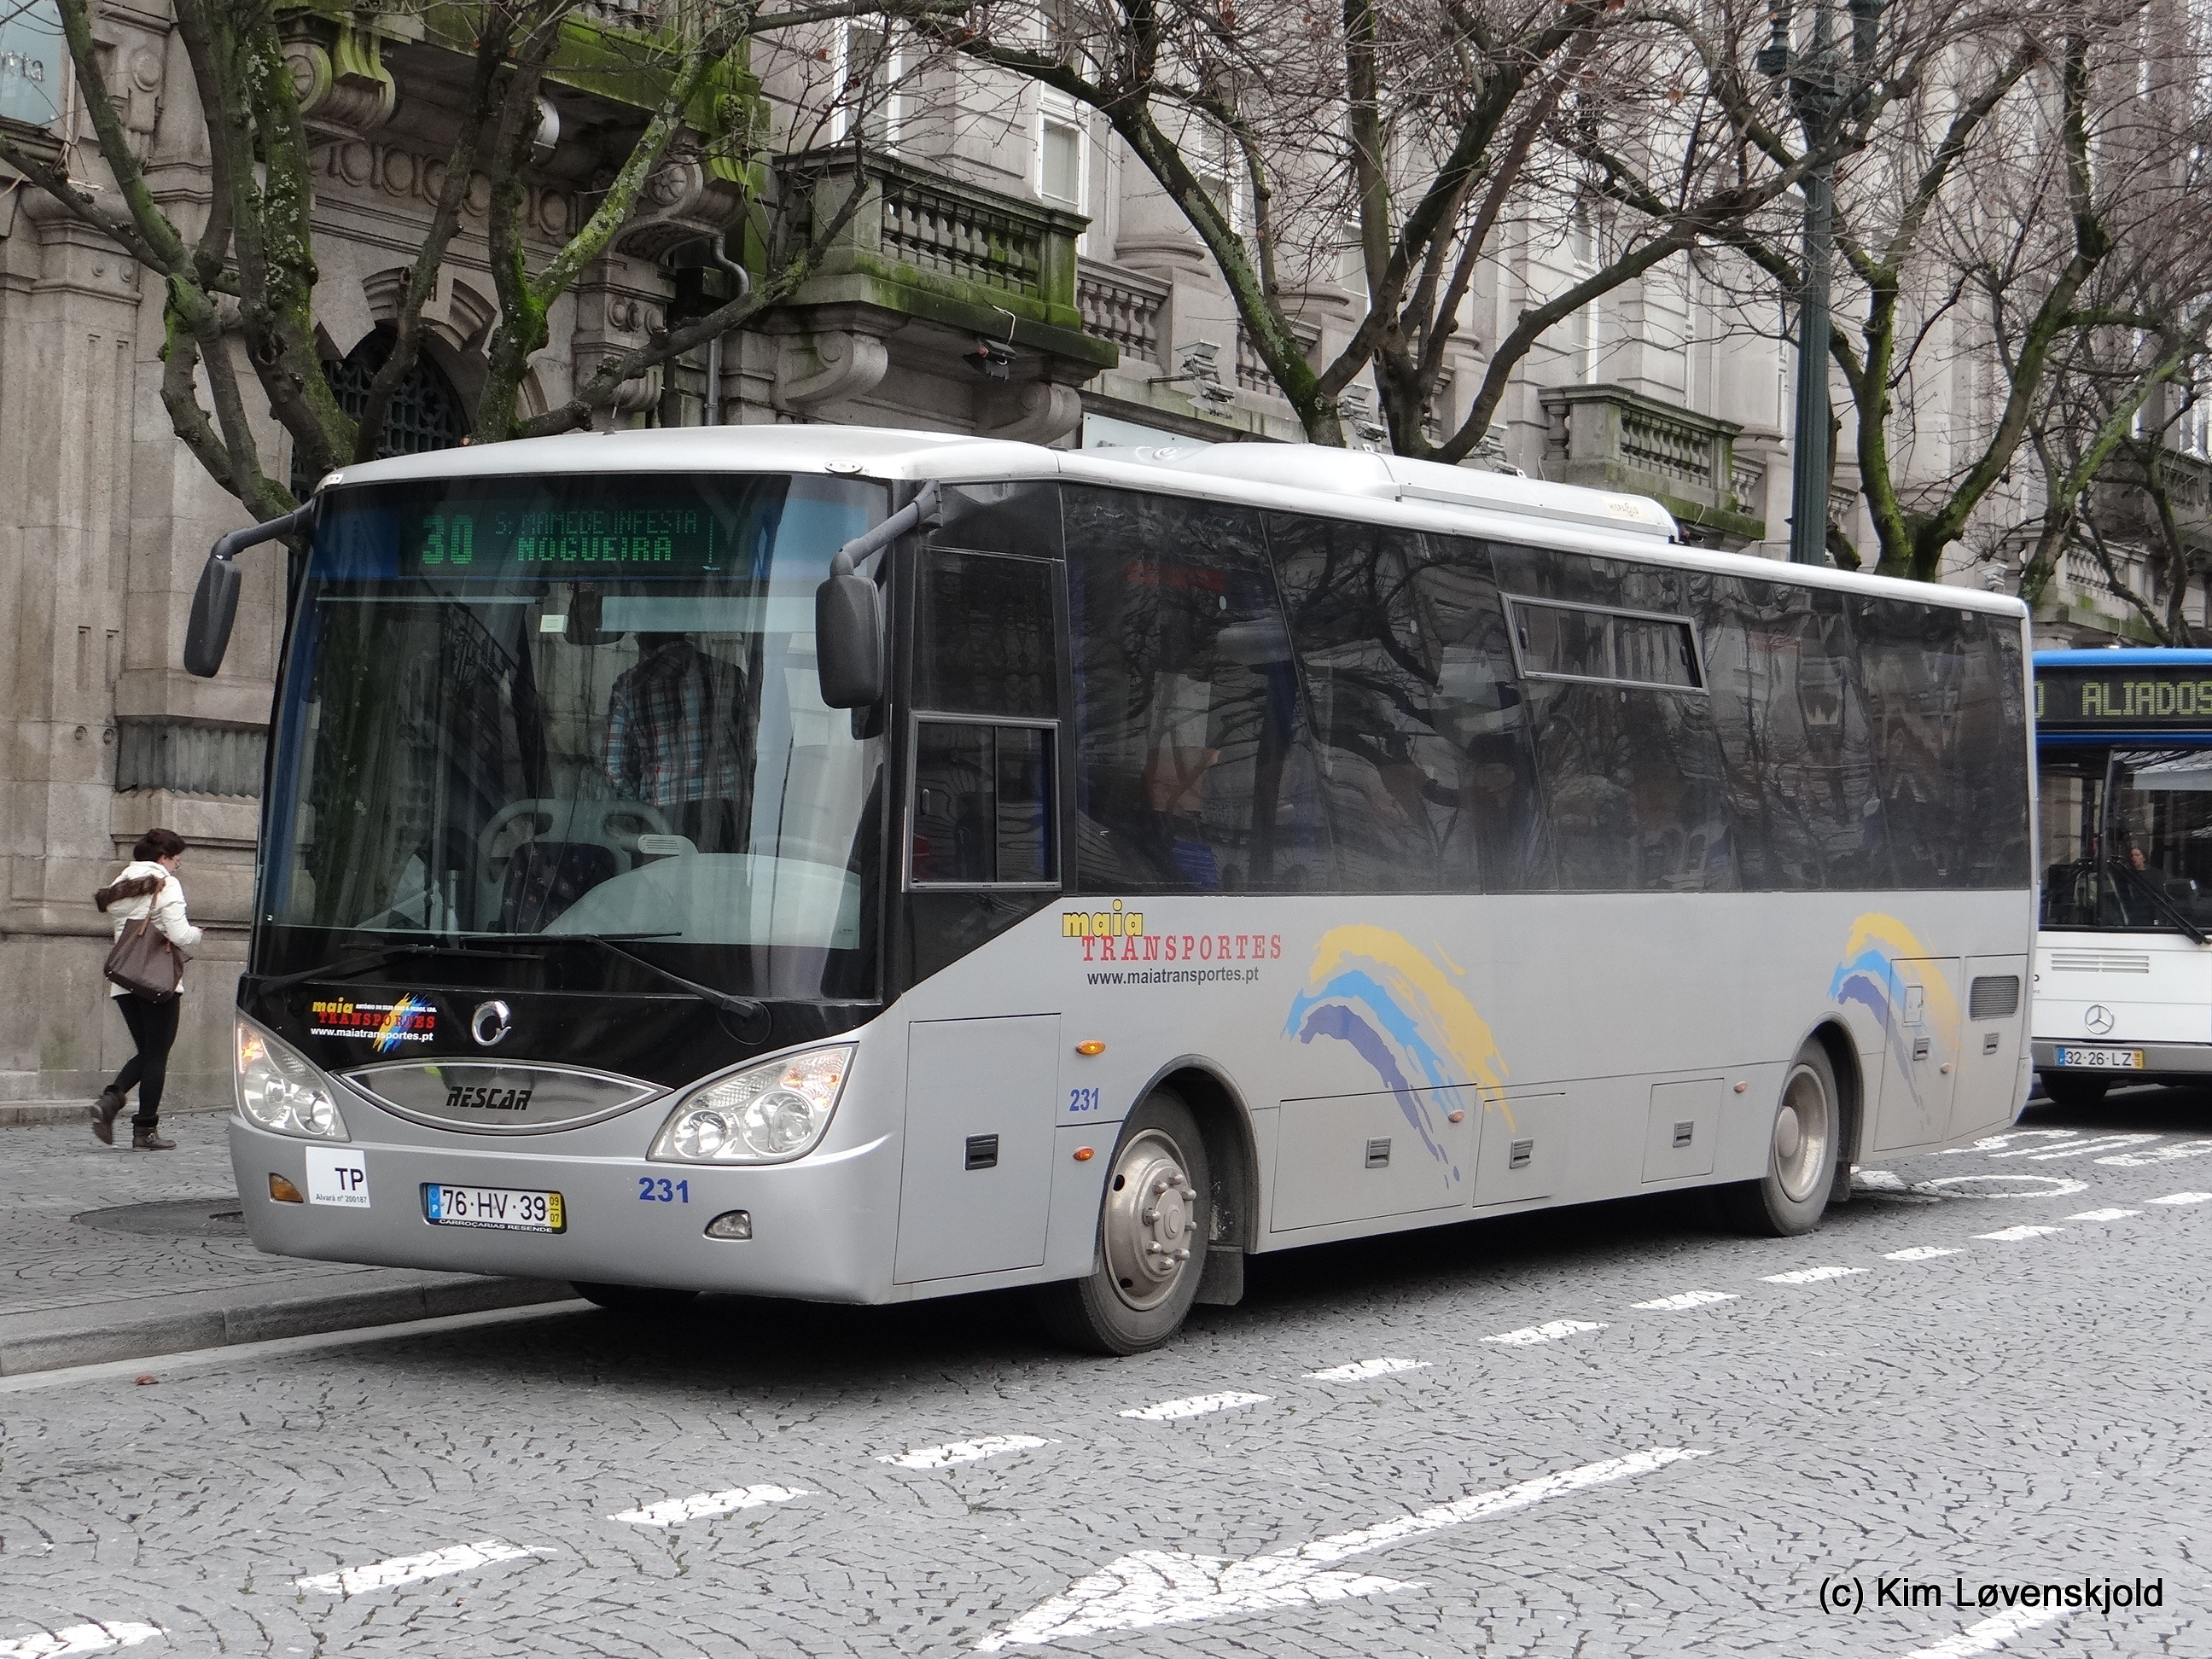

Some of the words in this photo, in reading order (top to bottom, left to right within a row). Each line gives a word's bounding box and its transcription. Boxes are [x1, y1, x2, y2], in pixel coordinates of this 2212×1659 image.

[521, 510, 604, 534] MAMEDE
[614, 510, 697, 534] INFESTA
[422, 515, 473, 564] 30
[517, 537, 672, 562] NOGUEIRA
[2081, 681, 2212, 716] ALIADOS
[1062, 899, 1144, 937] maia
[1081, 934, 1282, 962] TRANSPORTES
[1086, 966, 1259, 986] www.maiatransportes.pt
[311, 997, 353, 1013] maia
[318, 1011, 436, 1029] TRANSPORTES
[311, 1027, 434, 1042] www.maiatransportes.pt
[445, 1086, 533, 1111] RESCAR
[1069, 1087, 1099, 1111] 231
[335, 1167, 364, 1191] TP
[638, 1177, 689, 1203] 231
[346, 1195, 367, 1203] 200187
[432, 1204, 439, 1213] P
[549, 1196, 560, 1206] 09
[439, 1219, 506, 1230] CARROÇARIAS
[507, 1224, 553, 1233] RESENDE
[550, 1213, 560, 1223] 07
